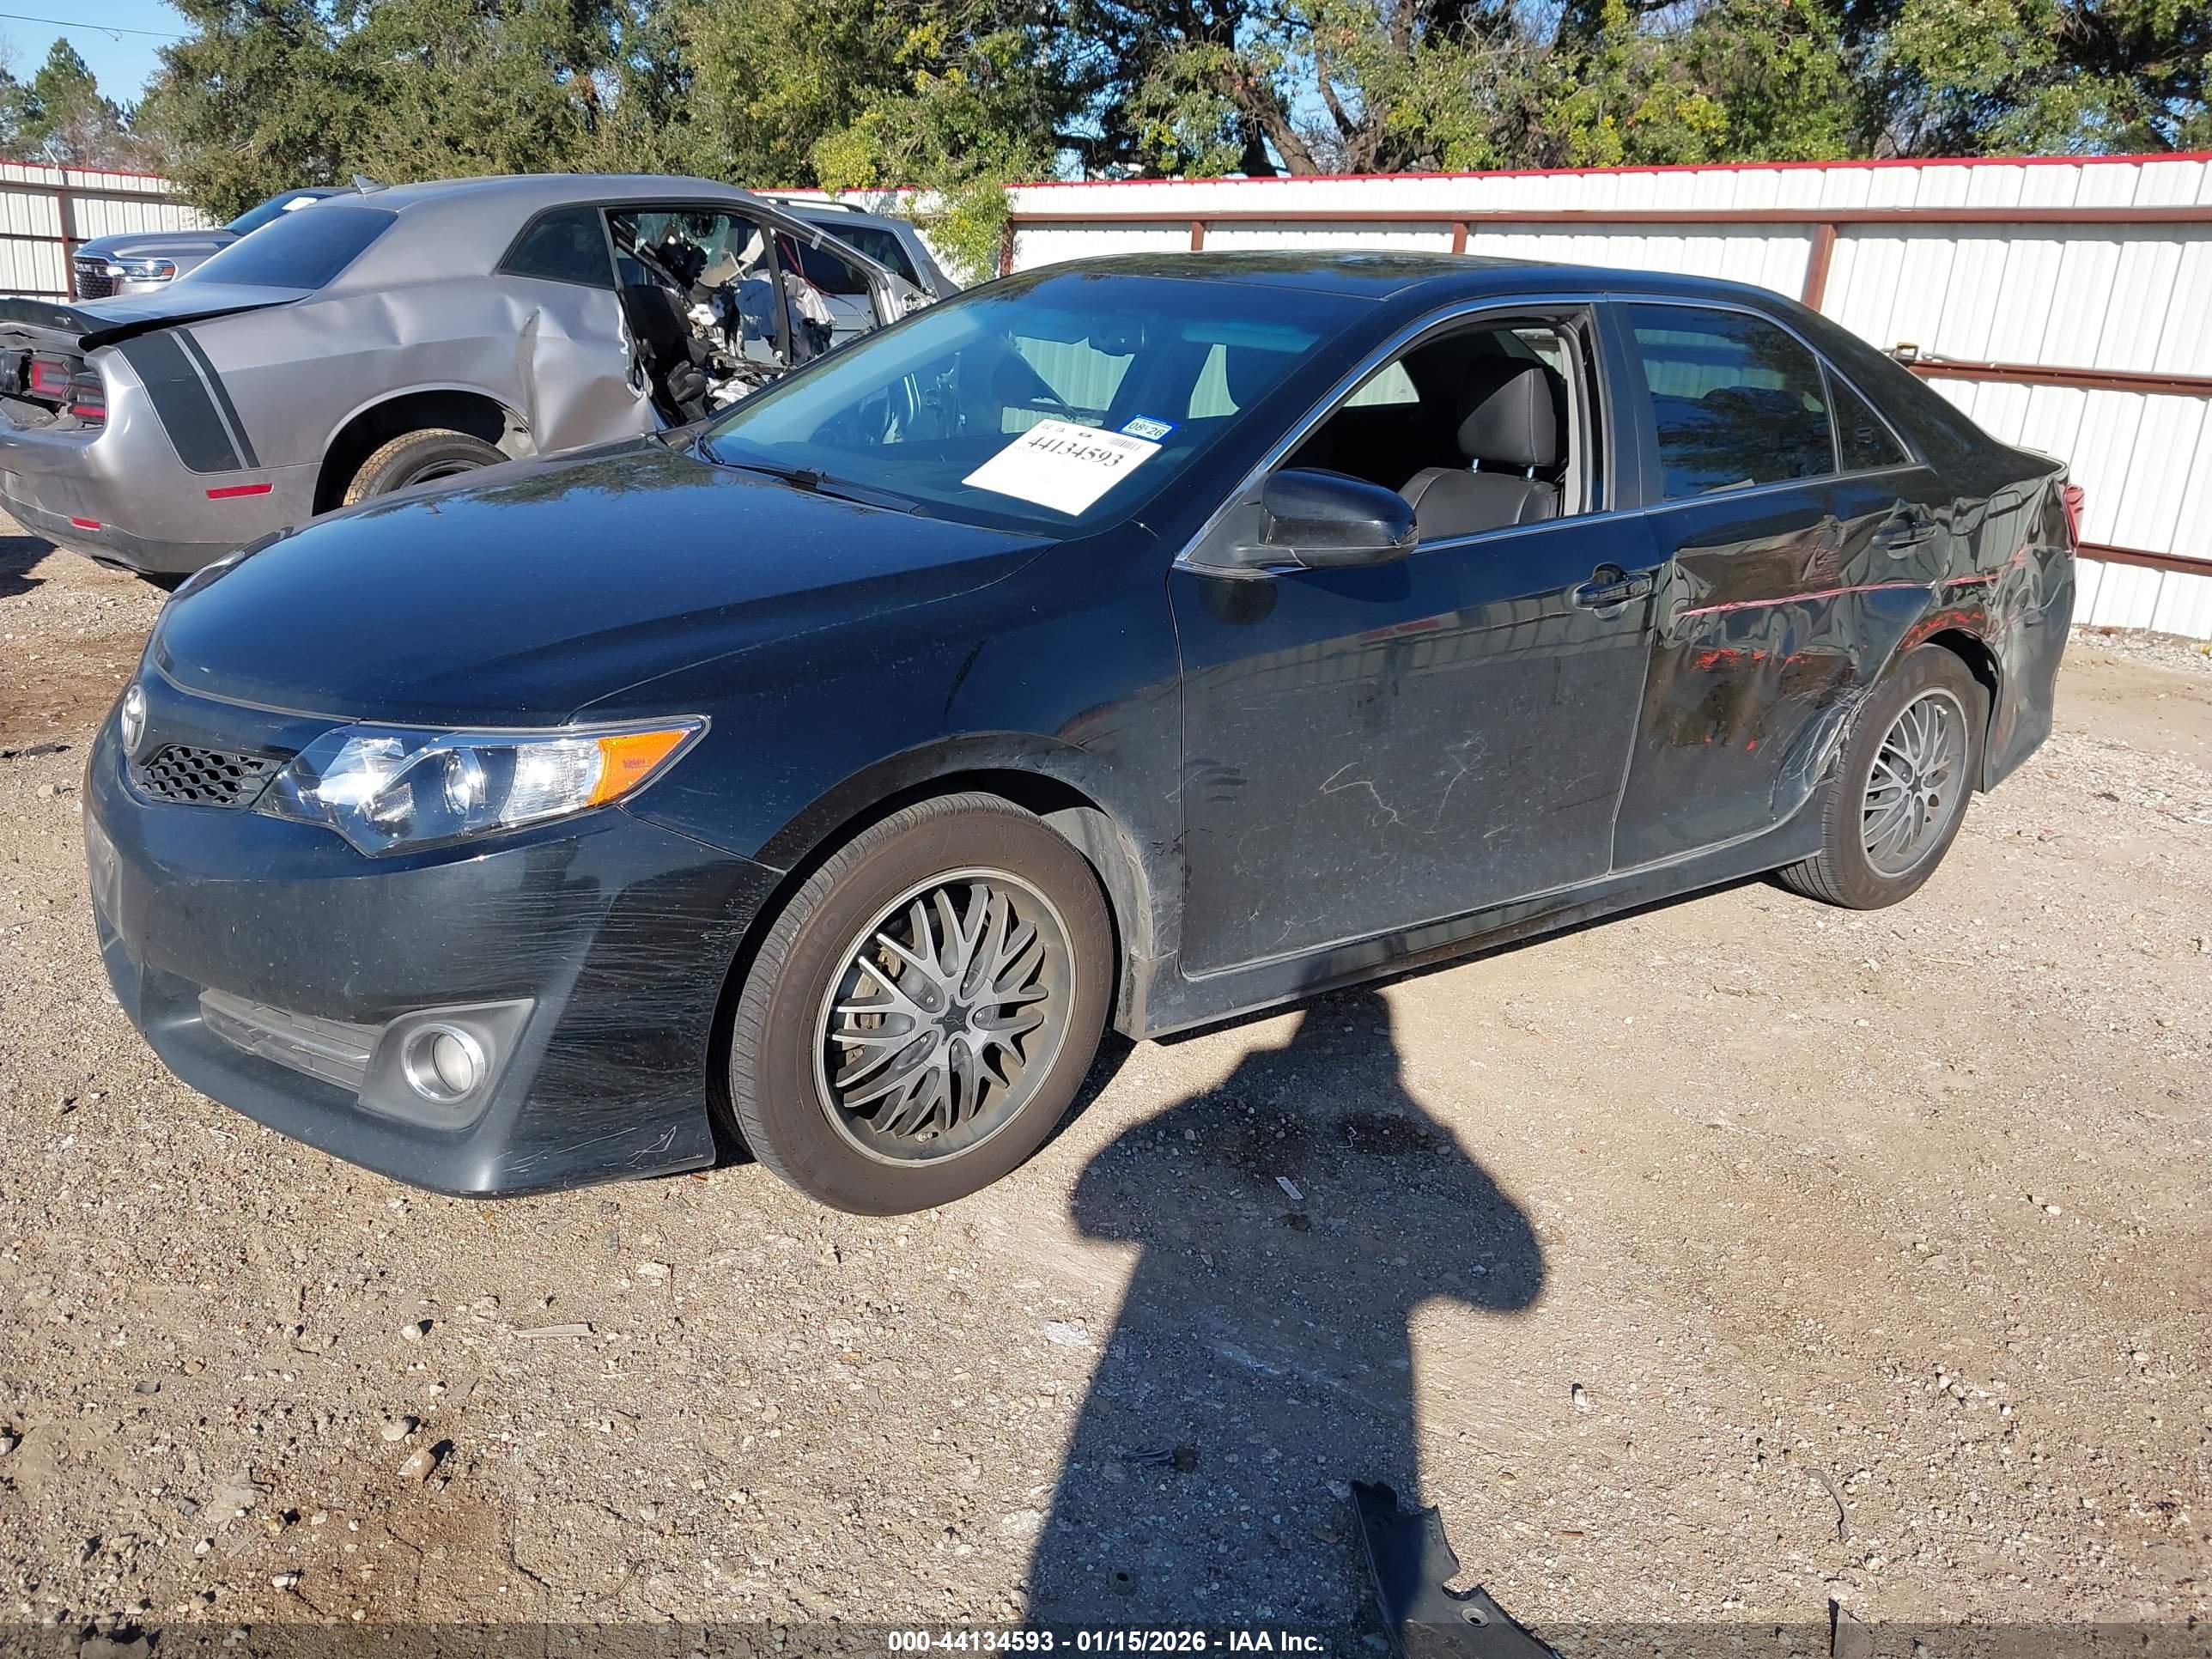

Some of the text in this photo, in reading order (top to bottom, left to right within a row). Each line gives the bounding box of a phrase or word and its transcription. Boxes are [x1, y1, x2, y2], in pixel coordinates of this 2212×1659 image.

[1129, 422, 1165, 436] 08 26
[1028, 436, 1124, 466] 44134593
